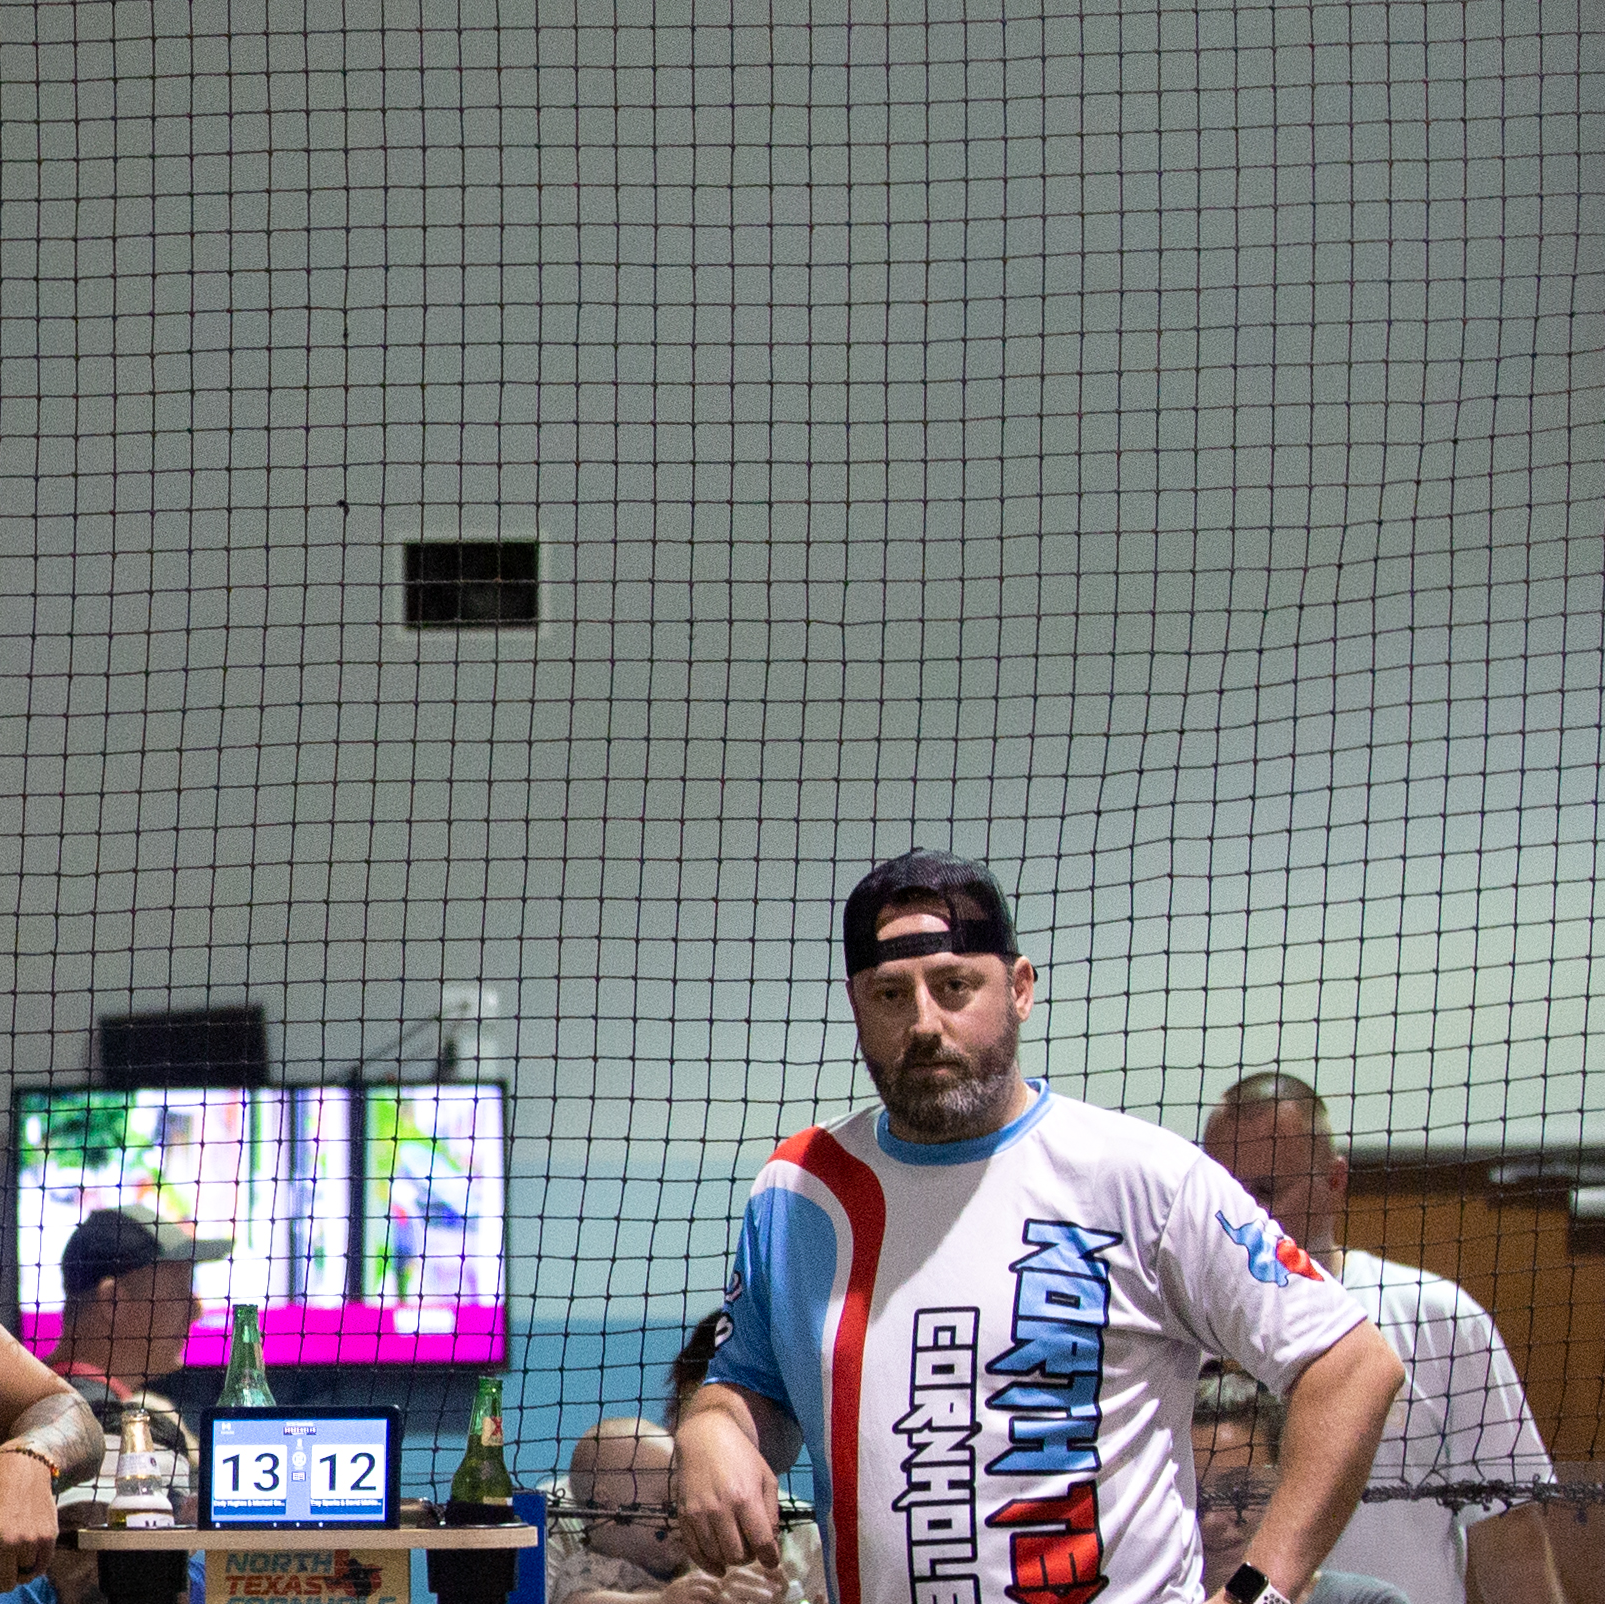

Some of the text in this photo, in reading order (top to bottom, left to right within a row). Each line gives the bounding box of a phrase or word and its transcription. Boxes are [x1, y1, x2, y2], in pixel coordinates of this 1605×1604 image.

[985, 1218, 1124, 1475] NORTH
[222, 1452, 280, 1492] 13
[319, 1452, 377, 1491] 12
[226, 1552, 334, 1573] NORTH
[226, 1575, 325, 1596] TEXAS
